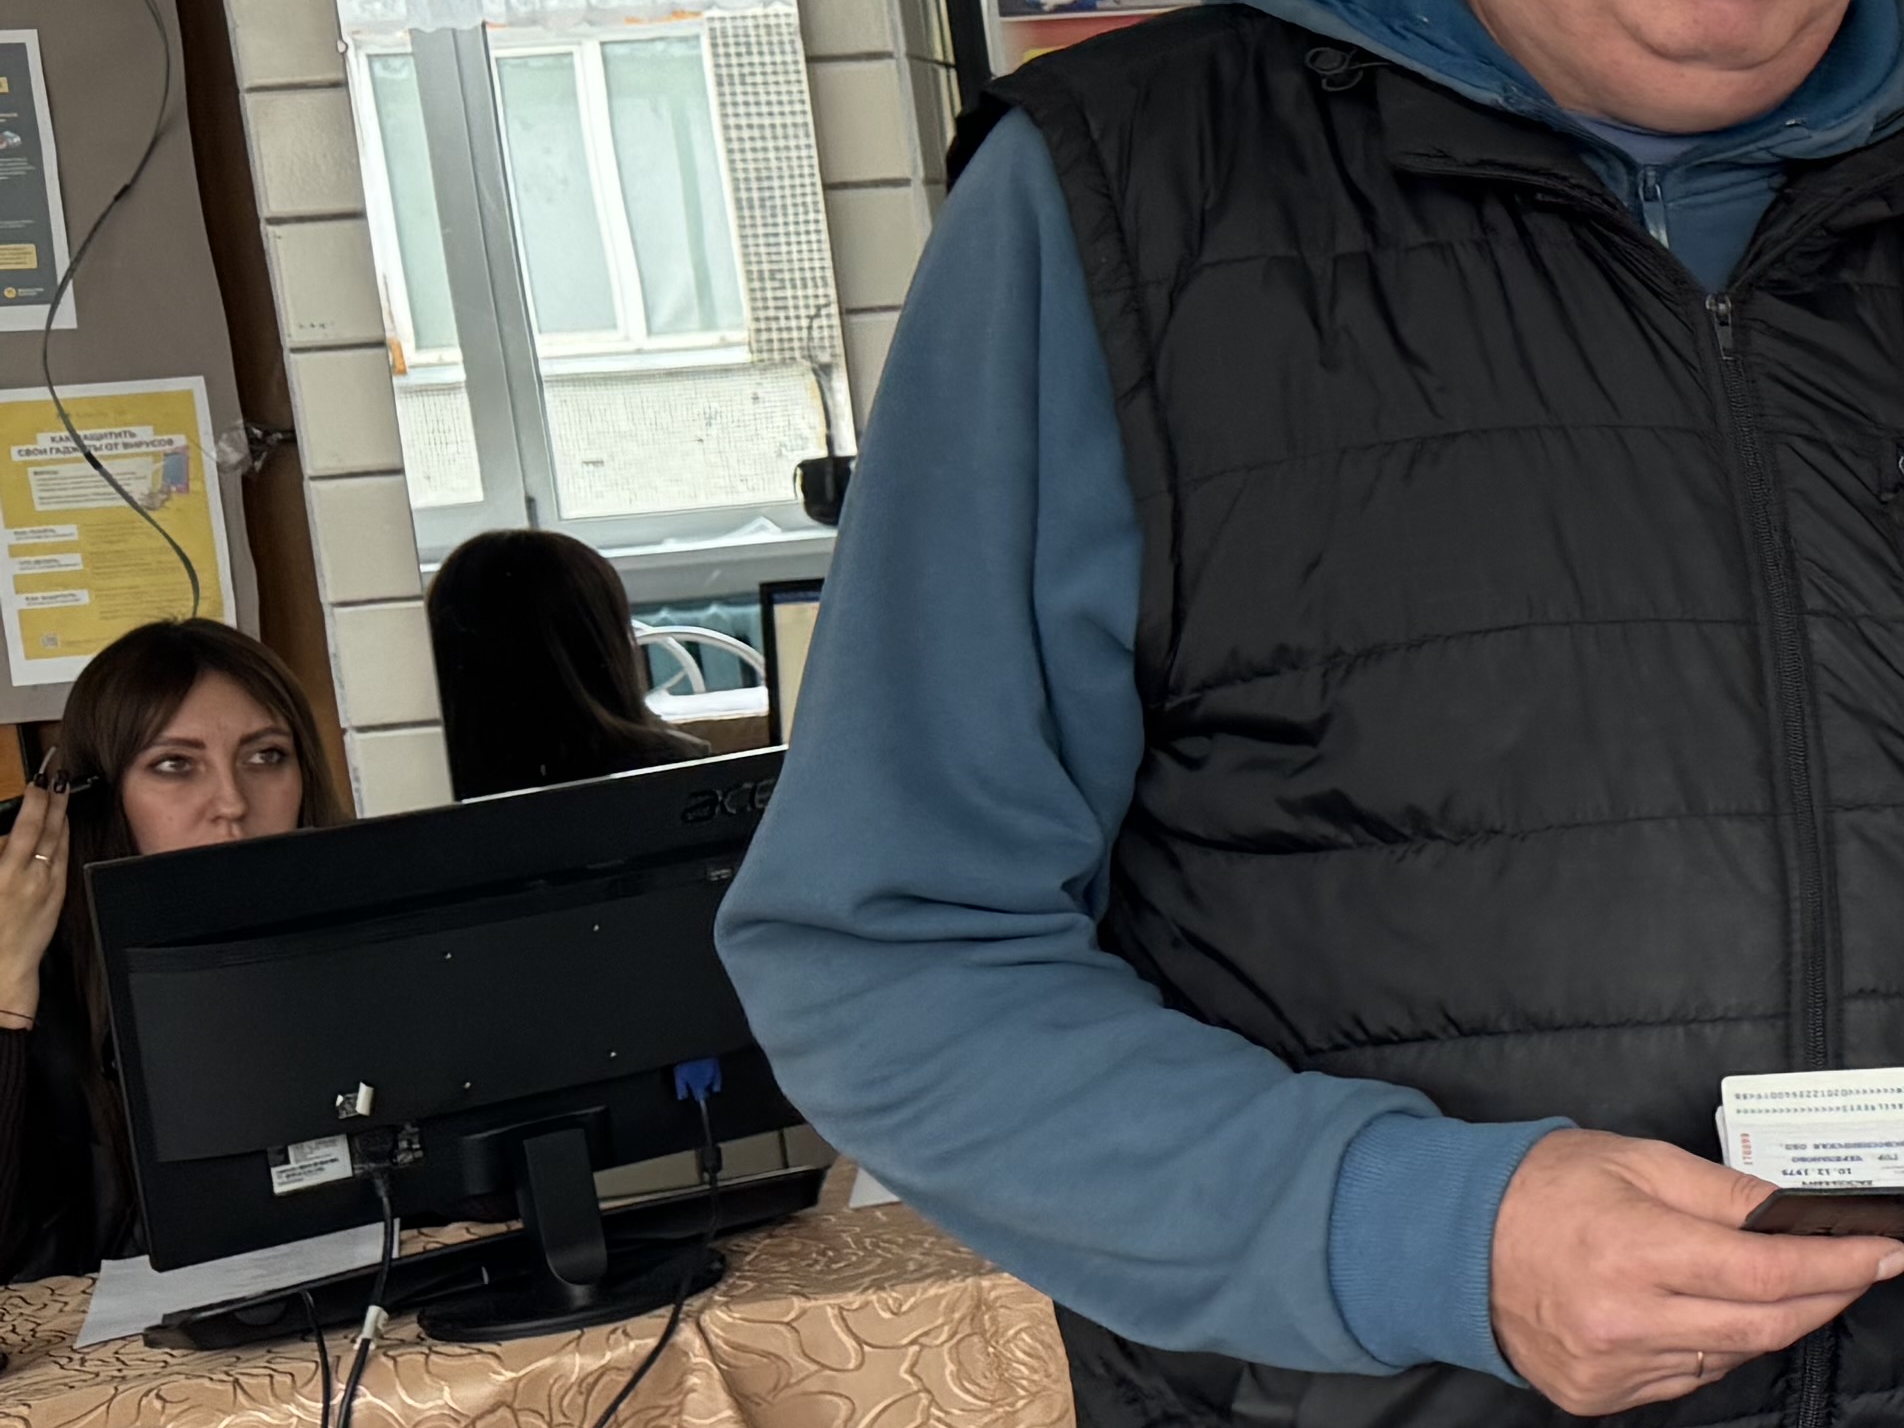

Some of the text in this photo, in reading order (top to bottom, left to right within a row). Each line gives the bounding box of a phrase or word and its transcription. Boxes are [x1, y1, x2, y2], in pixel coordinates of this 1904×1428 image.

[72, 430, 137, 443] АЩИТИТЬ
[49, 443, 104, 456] ГАДЖТЫ
[681, 778, 779, 823] ace
